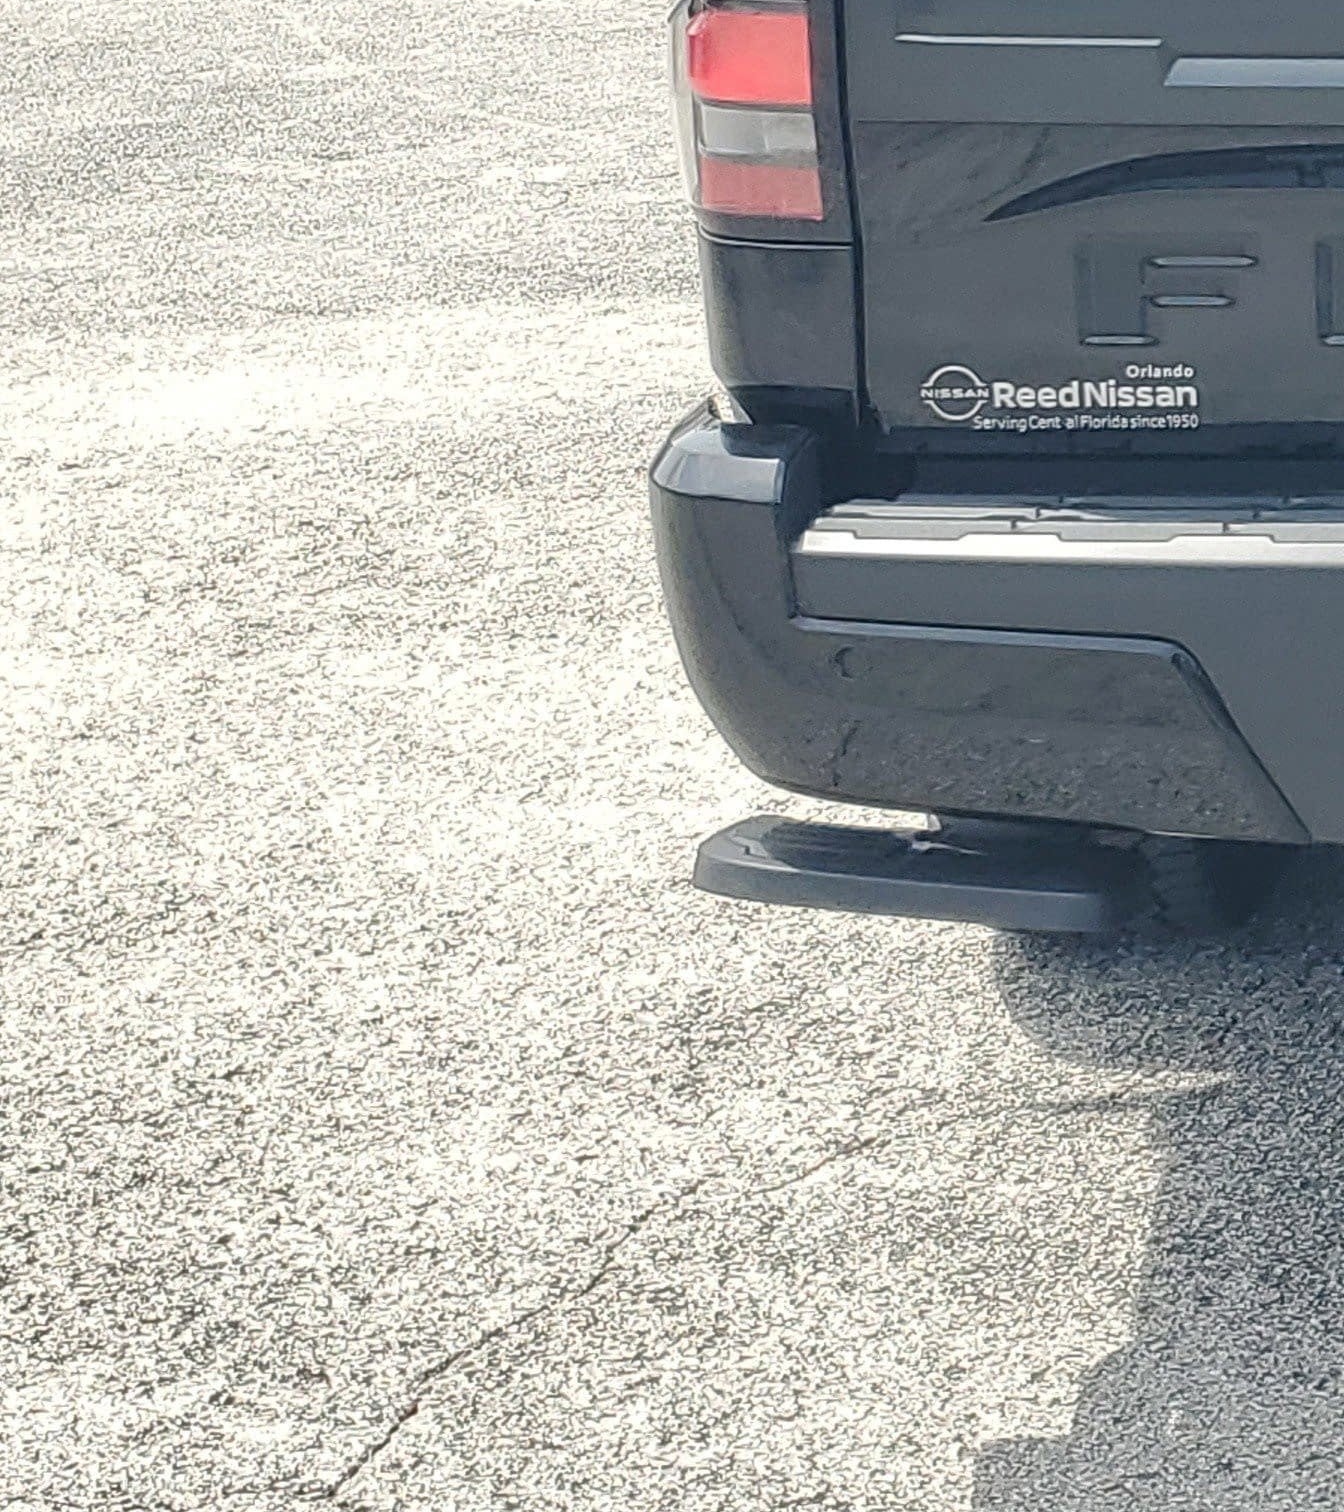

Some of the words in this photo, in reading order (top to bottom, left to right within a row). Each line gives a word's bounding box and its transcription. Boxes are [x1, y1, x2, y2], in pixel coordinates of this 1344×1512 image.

[1125, 364, 1194, 379] Orlando
[920, 388, 990, 400] NISSAN
[972, 415, 1027, 433] Serving
[1166, 413, 1199, 429] 1950
